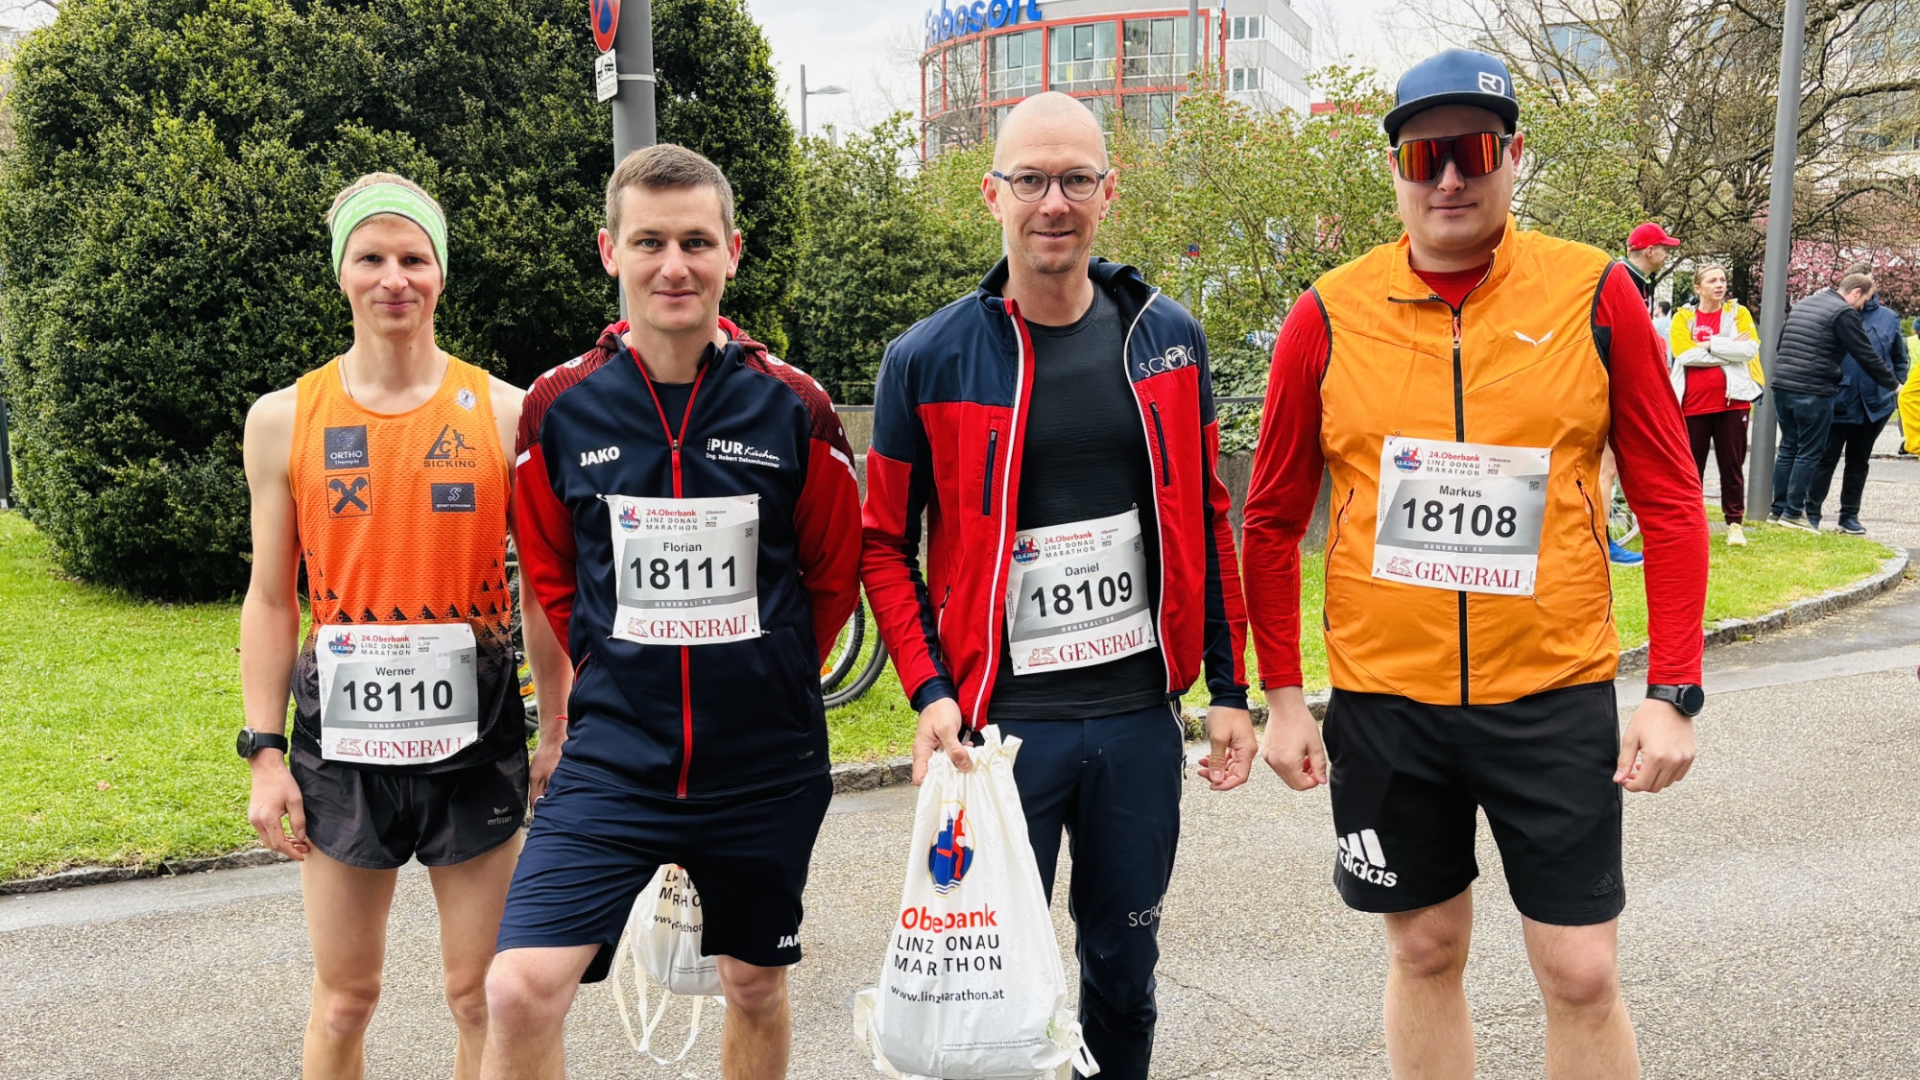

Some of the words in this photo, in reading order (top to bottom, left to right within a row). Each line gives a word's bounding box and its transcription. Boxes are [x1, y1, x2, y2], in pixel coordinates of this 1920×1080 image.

[330, 450, 362, 460] ORTHO
[580, 446, 620, 466] JAKO
[711, 438, 744, 455] PUR
[744, 446, 780, 461] Küchen
[719, 454, 738, 462] Robert
[1428, 451, 1480, 462] 24.Oberbank
[424, 460, 476, 468] SICKING
[1450, 461, 1480, 469] DONAU
[1426, 466, 1480, 476] MARATHON
[1439, 485, 1482, 498] Markus
[646, 509, 697, 517] 24.Oberbank
[1402, 497, 1517, 538] 18108
[1044, 531, 1093, 545] 24.Oberbank
[663, 542, 702, 552] Florian
[1044, 543, 1062, 551] LINZ
[1065, 539, 1095, 548] DONAU
[1423, 544, 1468, 552] GENERALI
[1045, 546, 1096, 558] MARATHON
[630, 555, 736, 590] 18111
[1065, 562, 1099, 577] Daniel
[1415, 561, 1521, 588] GENERALI
[1031, 571, 1133, 617] 18109
[650, 614, 747, 639] GENERALI
[1061, 620, 1103, 633] GENERALI
[361, 635, 409, 643] 24.Oberbank
[1060, 626, 1144, 663] GENERALI
[375, 666, 416, 676] Werner
[343, 680, 453, 712] 18110
[368, 720, 411, 728] GENERALI
[365, 736, 462, 759] GENERALI
[897, 934, 934, 954] LINZ
[946, 934, 999, 951] ONAU
[894, 954, 1002, 976] MARTHON
